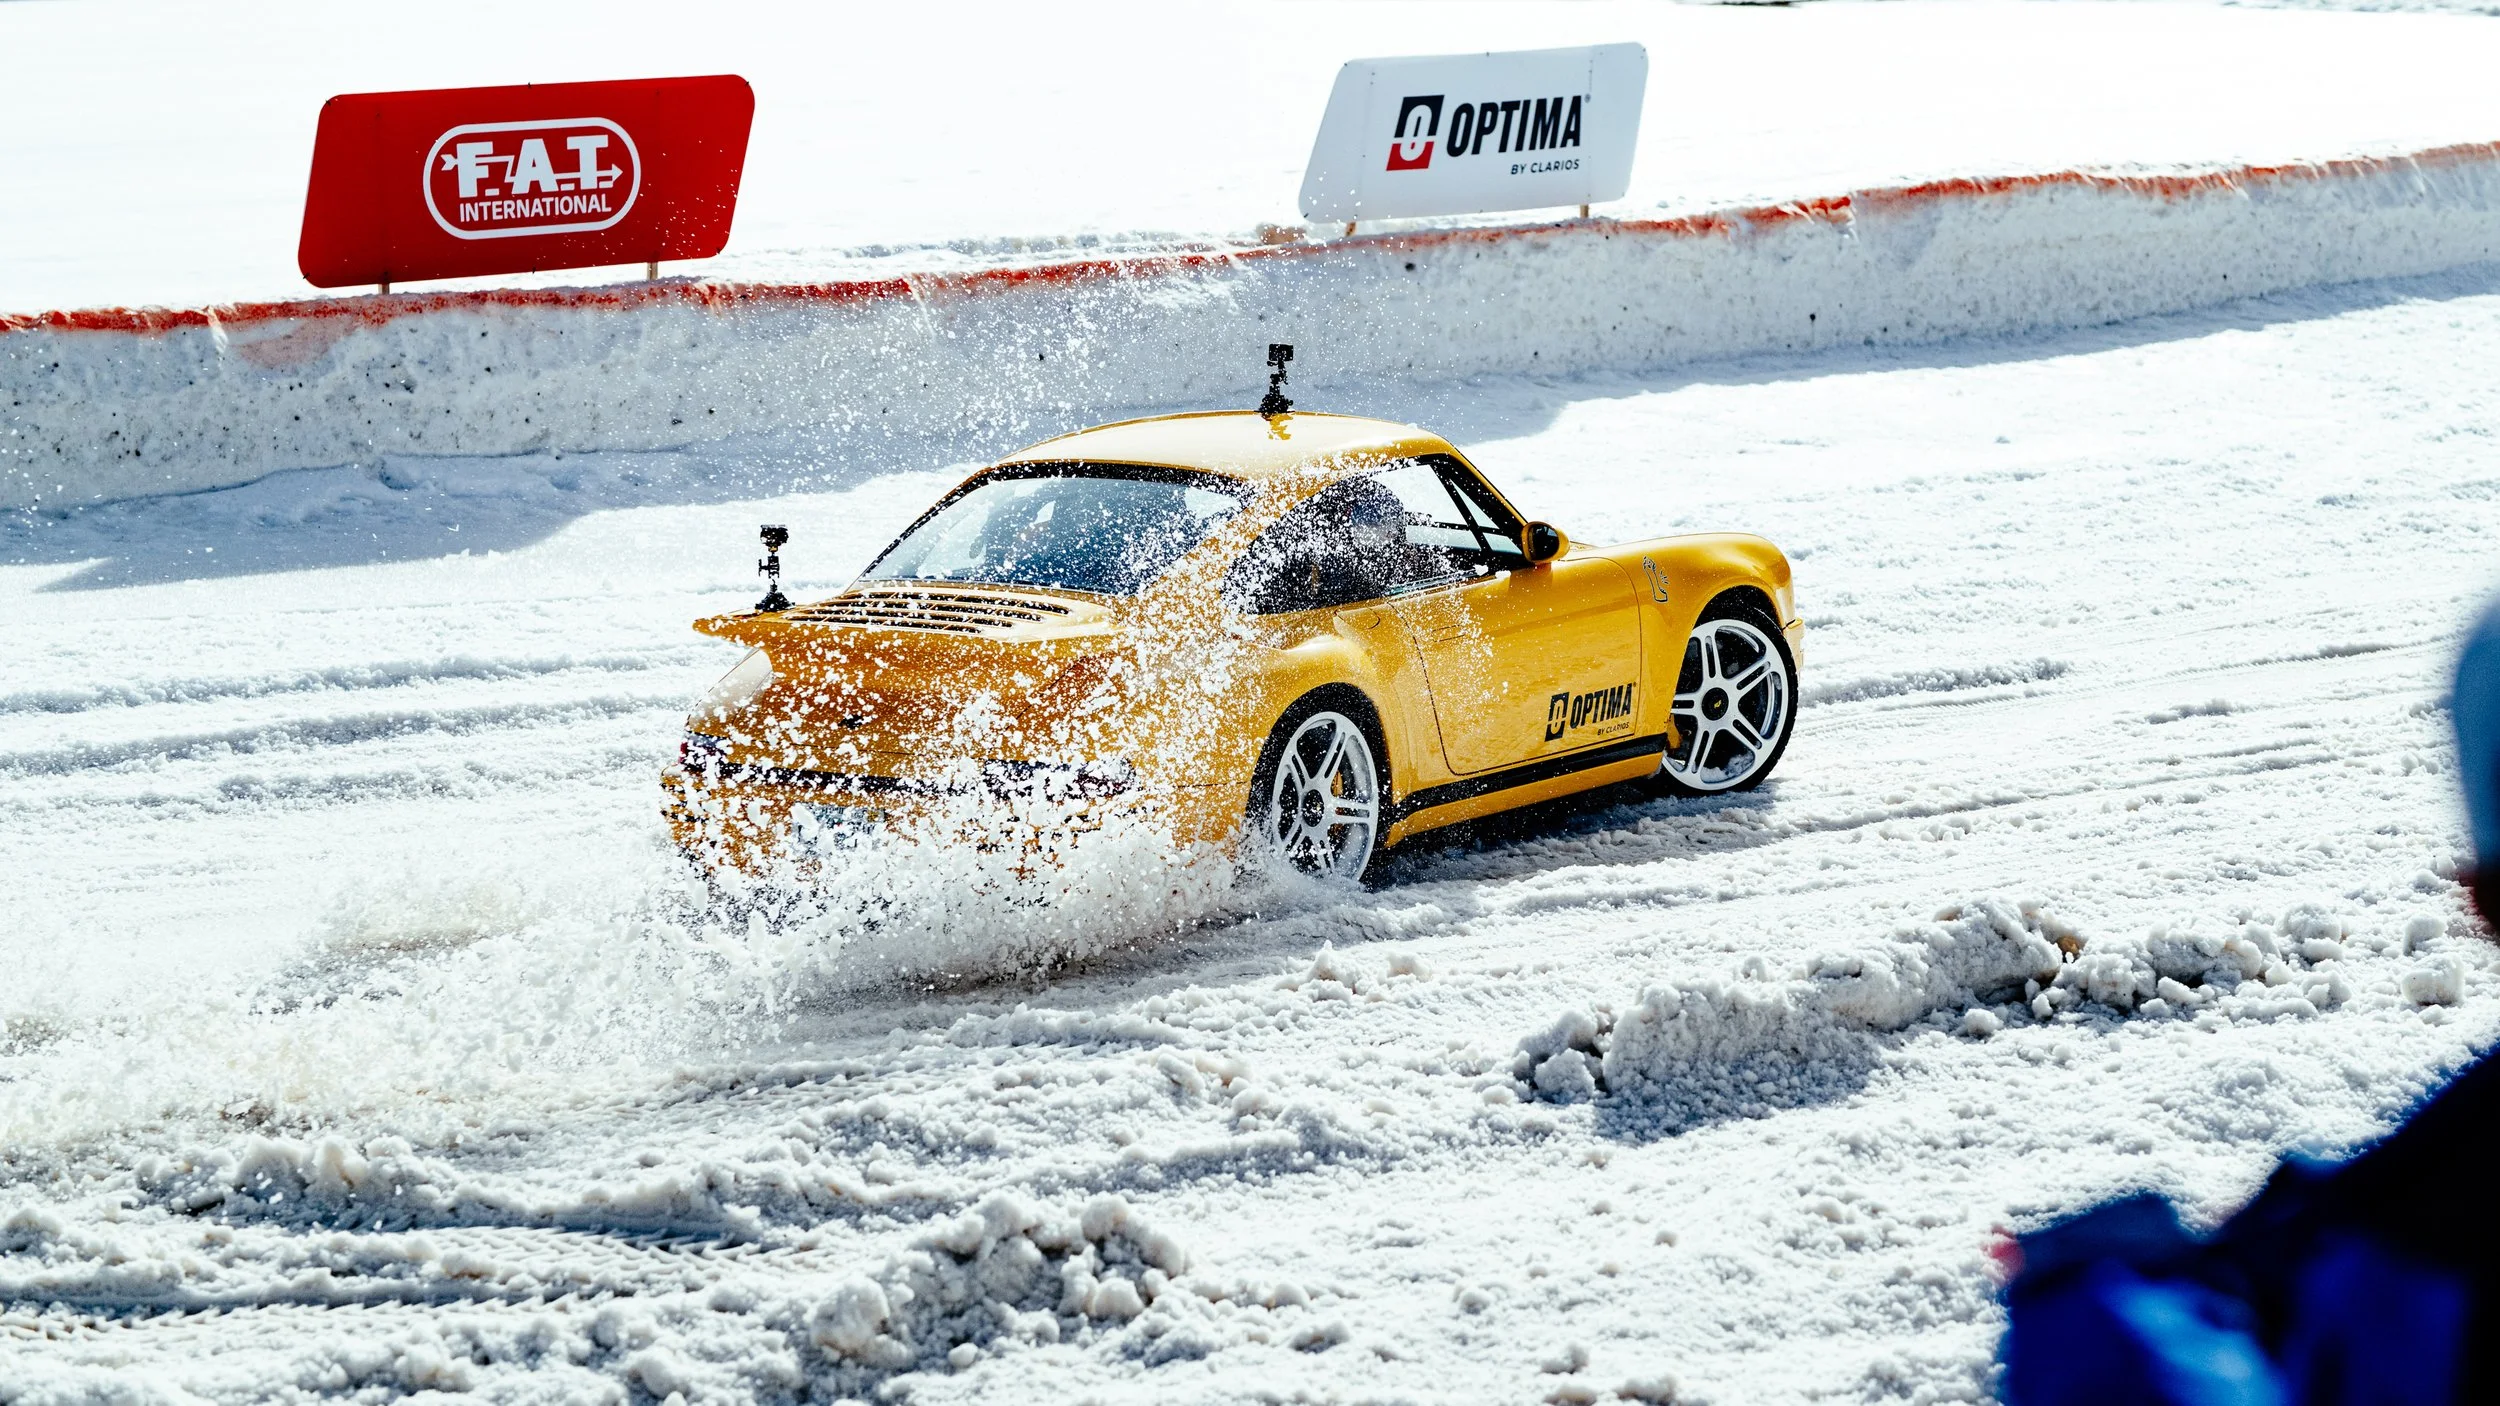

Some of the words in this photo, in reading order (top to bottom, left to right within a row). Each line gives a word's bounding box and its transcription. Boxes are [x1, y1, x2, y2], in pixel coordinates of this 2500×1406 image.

[1446, 95, 1582, 158] OPTIMA
[1511, 164, 1527, 175] BY
[1530, 159, 1580, 173] CLARIOS
[459, 193, 612, 222] INTERNATIONAL
[1569, 683, 1633, 729] OPTIMA
[1597, 728, 1605, 736] BY
[1606, 722, 1630, 734] CLARIOS
